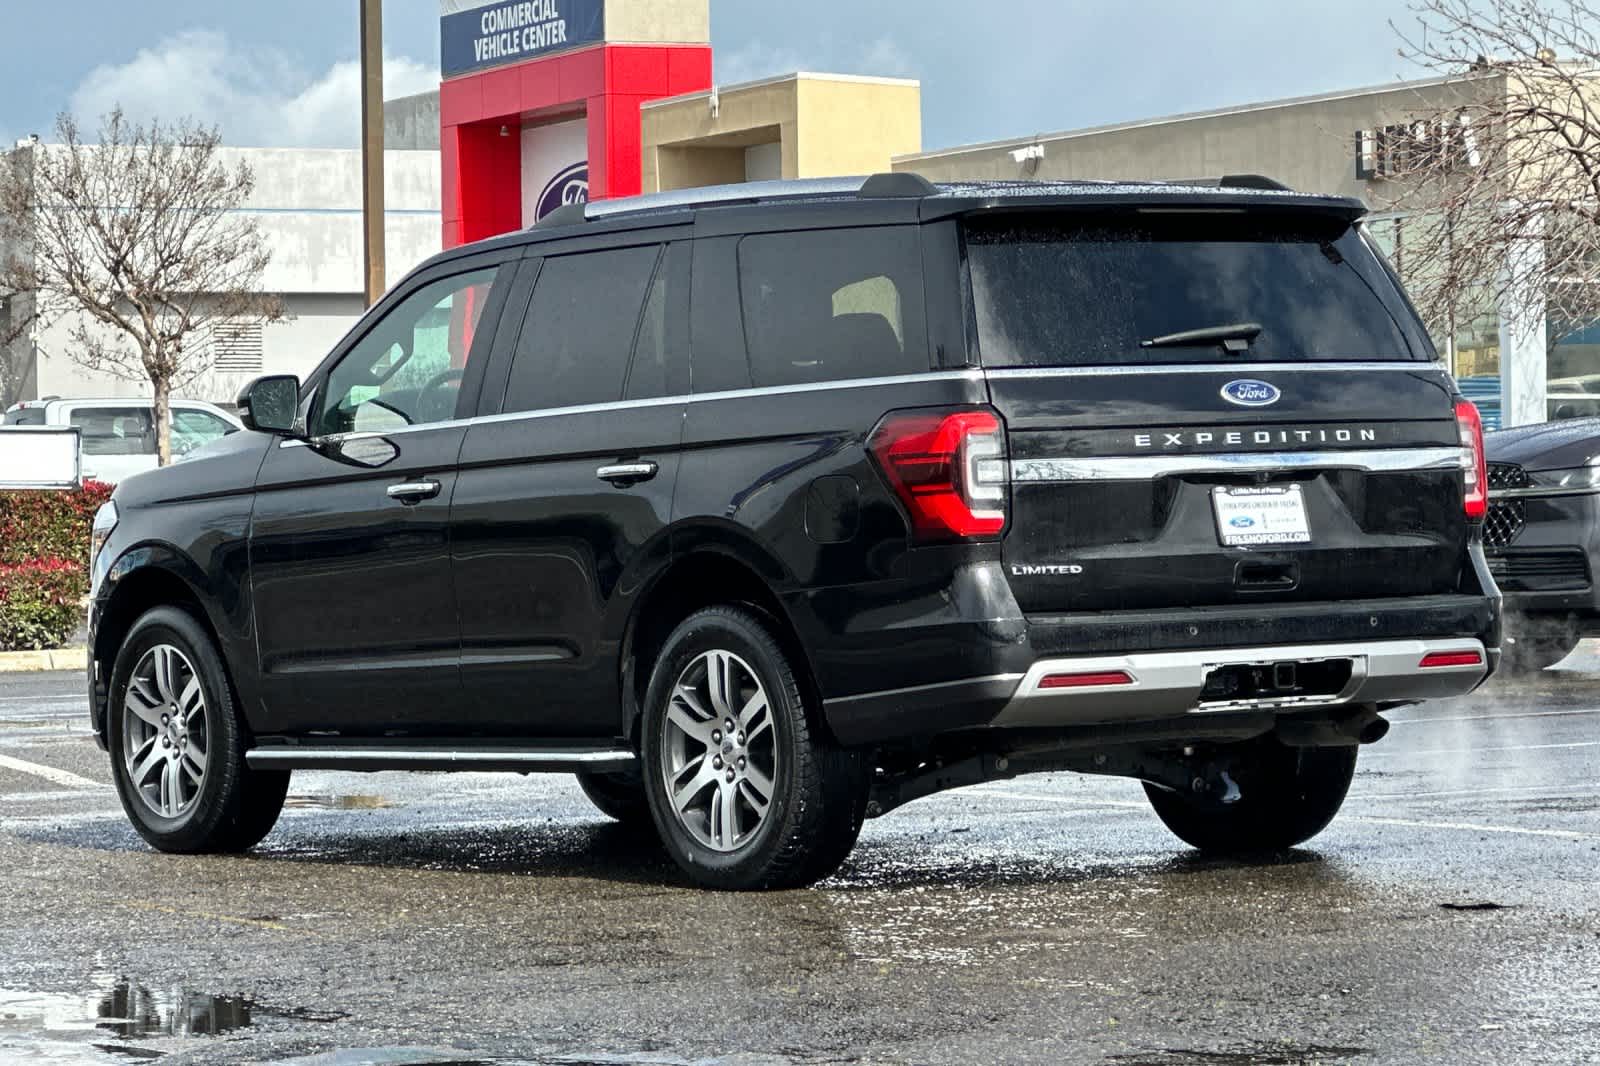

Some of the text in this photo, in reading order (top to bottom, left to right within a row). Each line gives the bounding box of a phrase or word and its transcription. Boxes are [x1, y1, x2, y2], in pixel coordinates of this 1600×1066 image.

[481, 0, 558, 35] COMMERCIAL
[474, 19, 567, 61] VEHICLE CENTER
[1237, 383, 1269, 401] Ford
[1134, 429, 1375, 447] EXPEDITION
[1011, 565, 1083, 576] LIMITED
